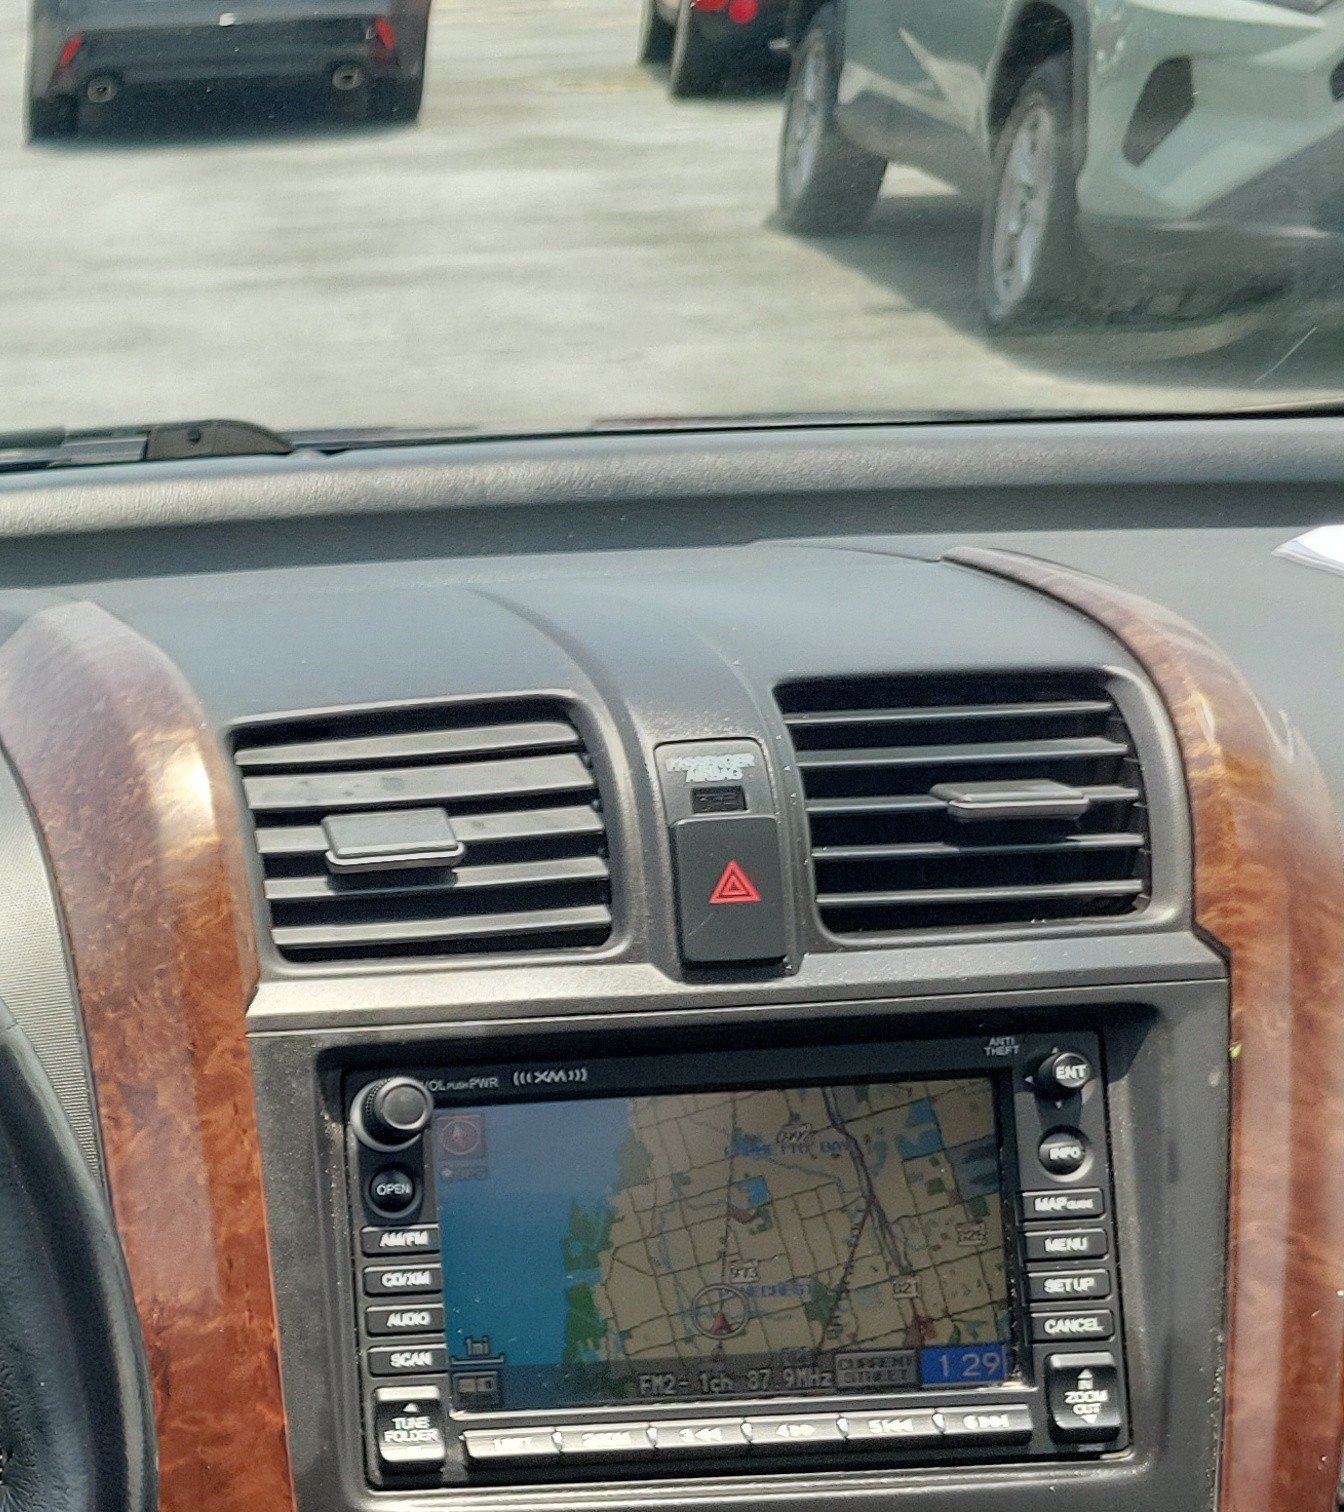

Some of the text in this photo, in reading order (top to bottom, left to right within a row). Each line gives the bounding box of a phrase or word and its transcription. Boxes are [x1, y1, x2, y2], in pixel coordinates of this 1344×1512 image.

[1055, 1063, 1089, 1080] ENT
[376, 1182, 412, 1196] OPEN
[1035, 1197, 1067, 1212] MAP
[379, 1230, 430, 1247] AM/FM
[1044, 1236, 1089, 1252] MENU
[386, 1311, 431, 1327] AUDIO
[1044, 1316, 1104, 1336] CANCEL
[390, 1351, 433, 1368] SCAN
[1064, 1389, 1108, 1404] ZOOM
[392, 1415, 431, 1430] TUNE
[963, 1414, 977, 1430] 6
[384, 1428, 439, 1443] FOLDER
